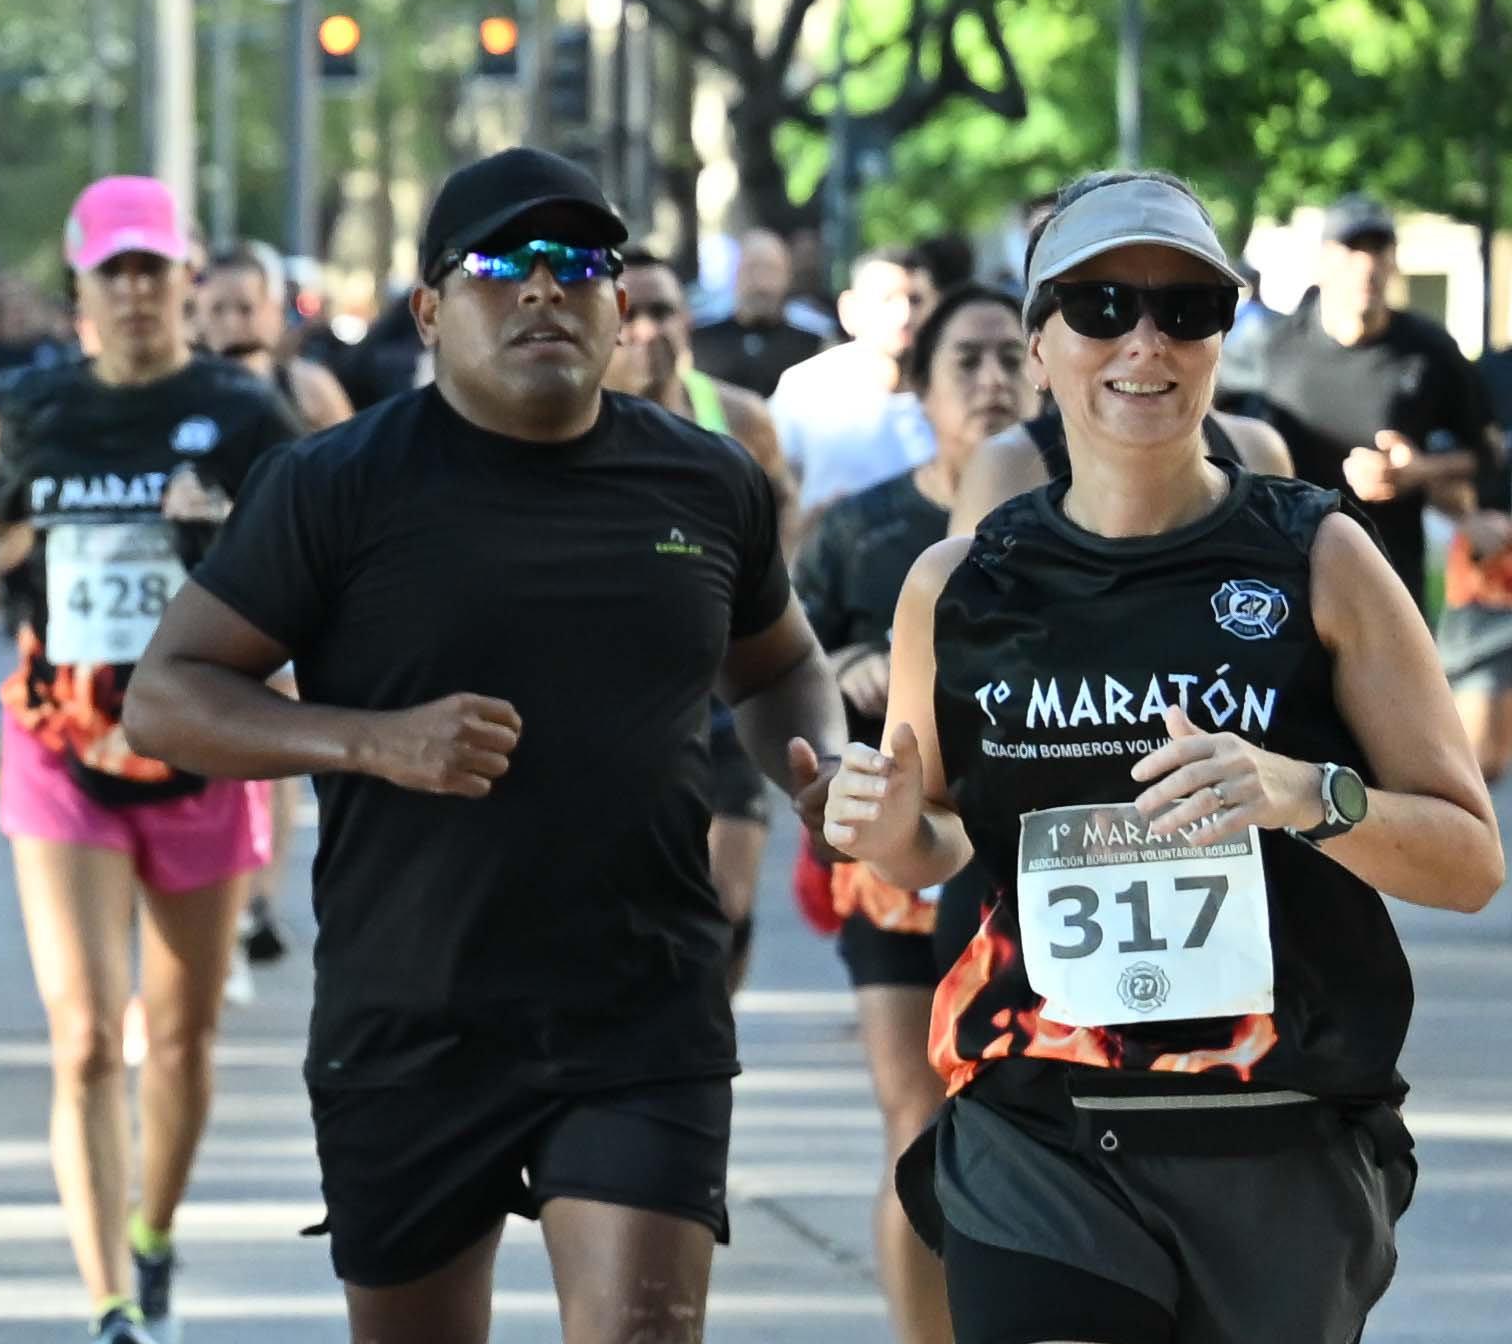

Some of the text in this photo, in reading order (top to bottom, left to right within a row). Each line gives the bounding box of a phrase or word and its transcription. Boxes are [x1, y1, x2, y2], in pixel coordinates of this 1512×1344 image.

[67, 574, 167, 618] 428
[1026, 663, 1276, 731] MARATÓN
[1040, 740, 1123, 758] BOMBEROS
[1028, 843, 1248, 872] ASOCIACIÓN BOMBEROS VOLUNTARIOS ROSARIO
[1048, 874, 1229, 960] 317
